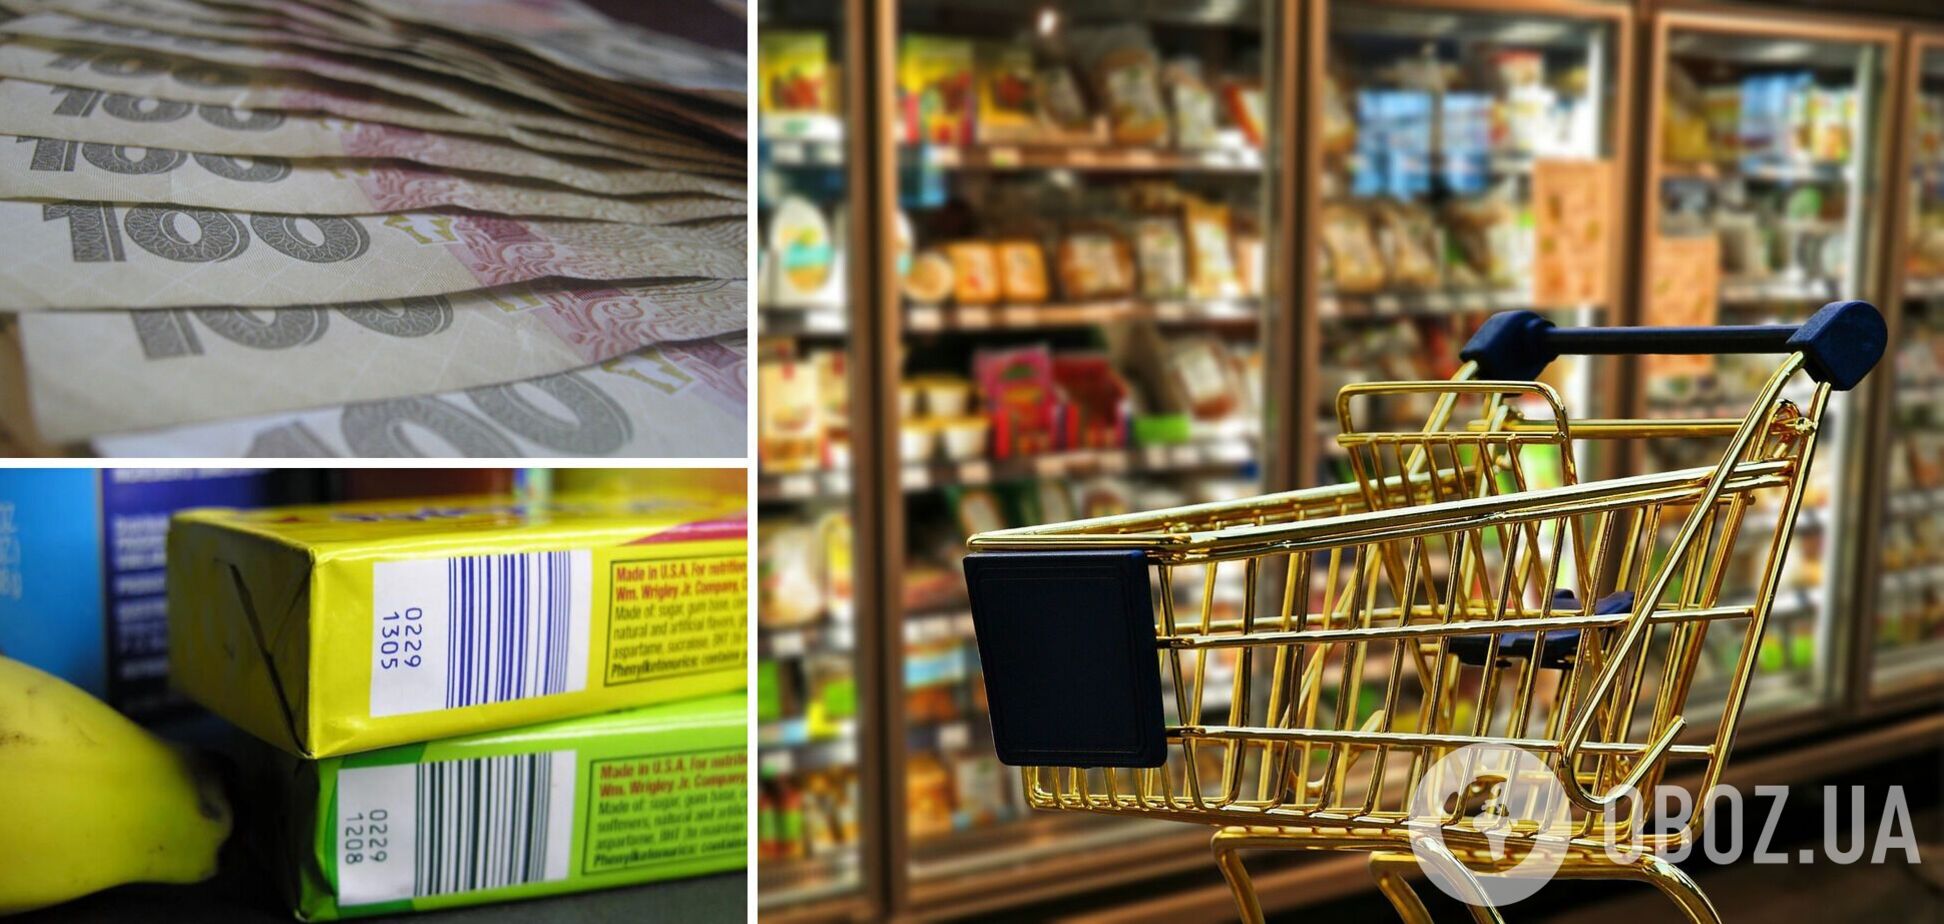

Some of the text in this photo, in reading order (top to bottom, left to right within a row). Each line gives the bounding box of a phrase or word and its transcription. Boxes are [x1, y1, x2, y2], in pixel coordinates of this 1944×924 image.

[43, 200, 371, 264] 100
[616, 567, 645, 581] Made
[648, 567, 657, 580] in
[691, 562, 706, 576] For
[616, 587, 639, 601] Wm.
[641, 584, 679, 600] Wrigley
[615, 605, 641, 620] Made
[381, 611, 400, 669] 1305
[404, 607, 423, 668] 0229
[614, 625, 648, 640] natural
[650, 621, 668, 635] and
[600, 764, 634, 779] Made
[638, 761, 649, 776] in
[690, 757, 707, 772] For
[630, 779, 674, 797] Wrigley
[599, 801, 629, 815] Made
[695, 807, 715, 822] and
[345, 812, 364, 865] 1208
[369, 809, 388, 862] 0229
